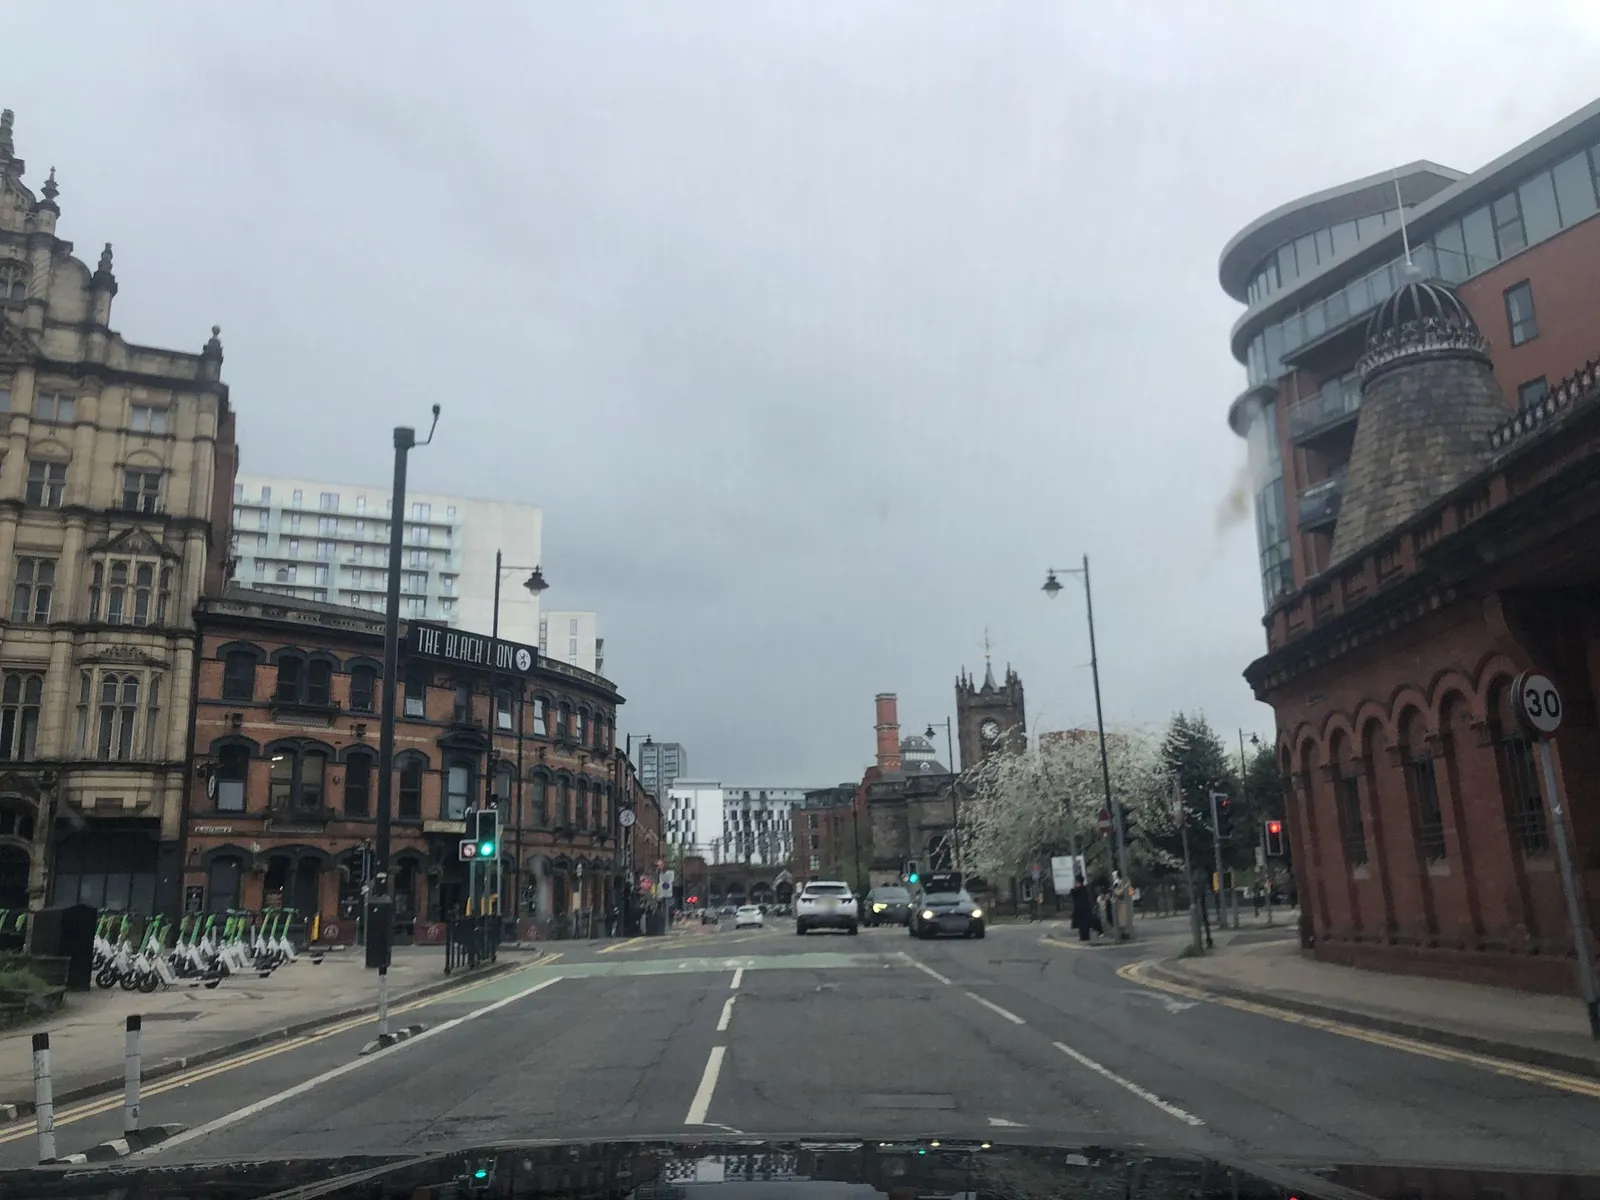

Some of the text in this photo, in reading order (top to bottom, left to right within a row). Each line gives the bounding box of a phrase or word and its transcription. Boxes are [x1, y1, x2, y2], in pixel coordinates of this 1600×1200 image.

[417, 627, 513, 670] THE BLACK LON
[1526, 688, 1559, 717] 30
